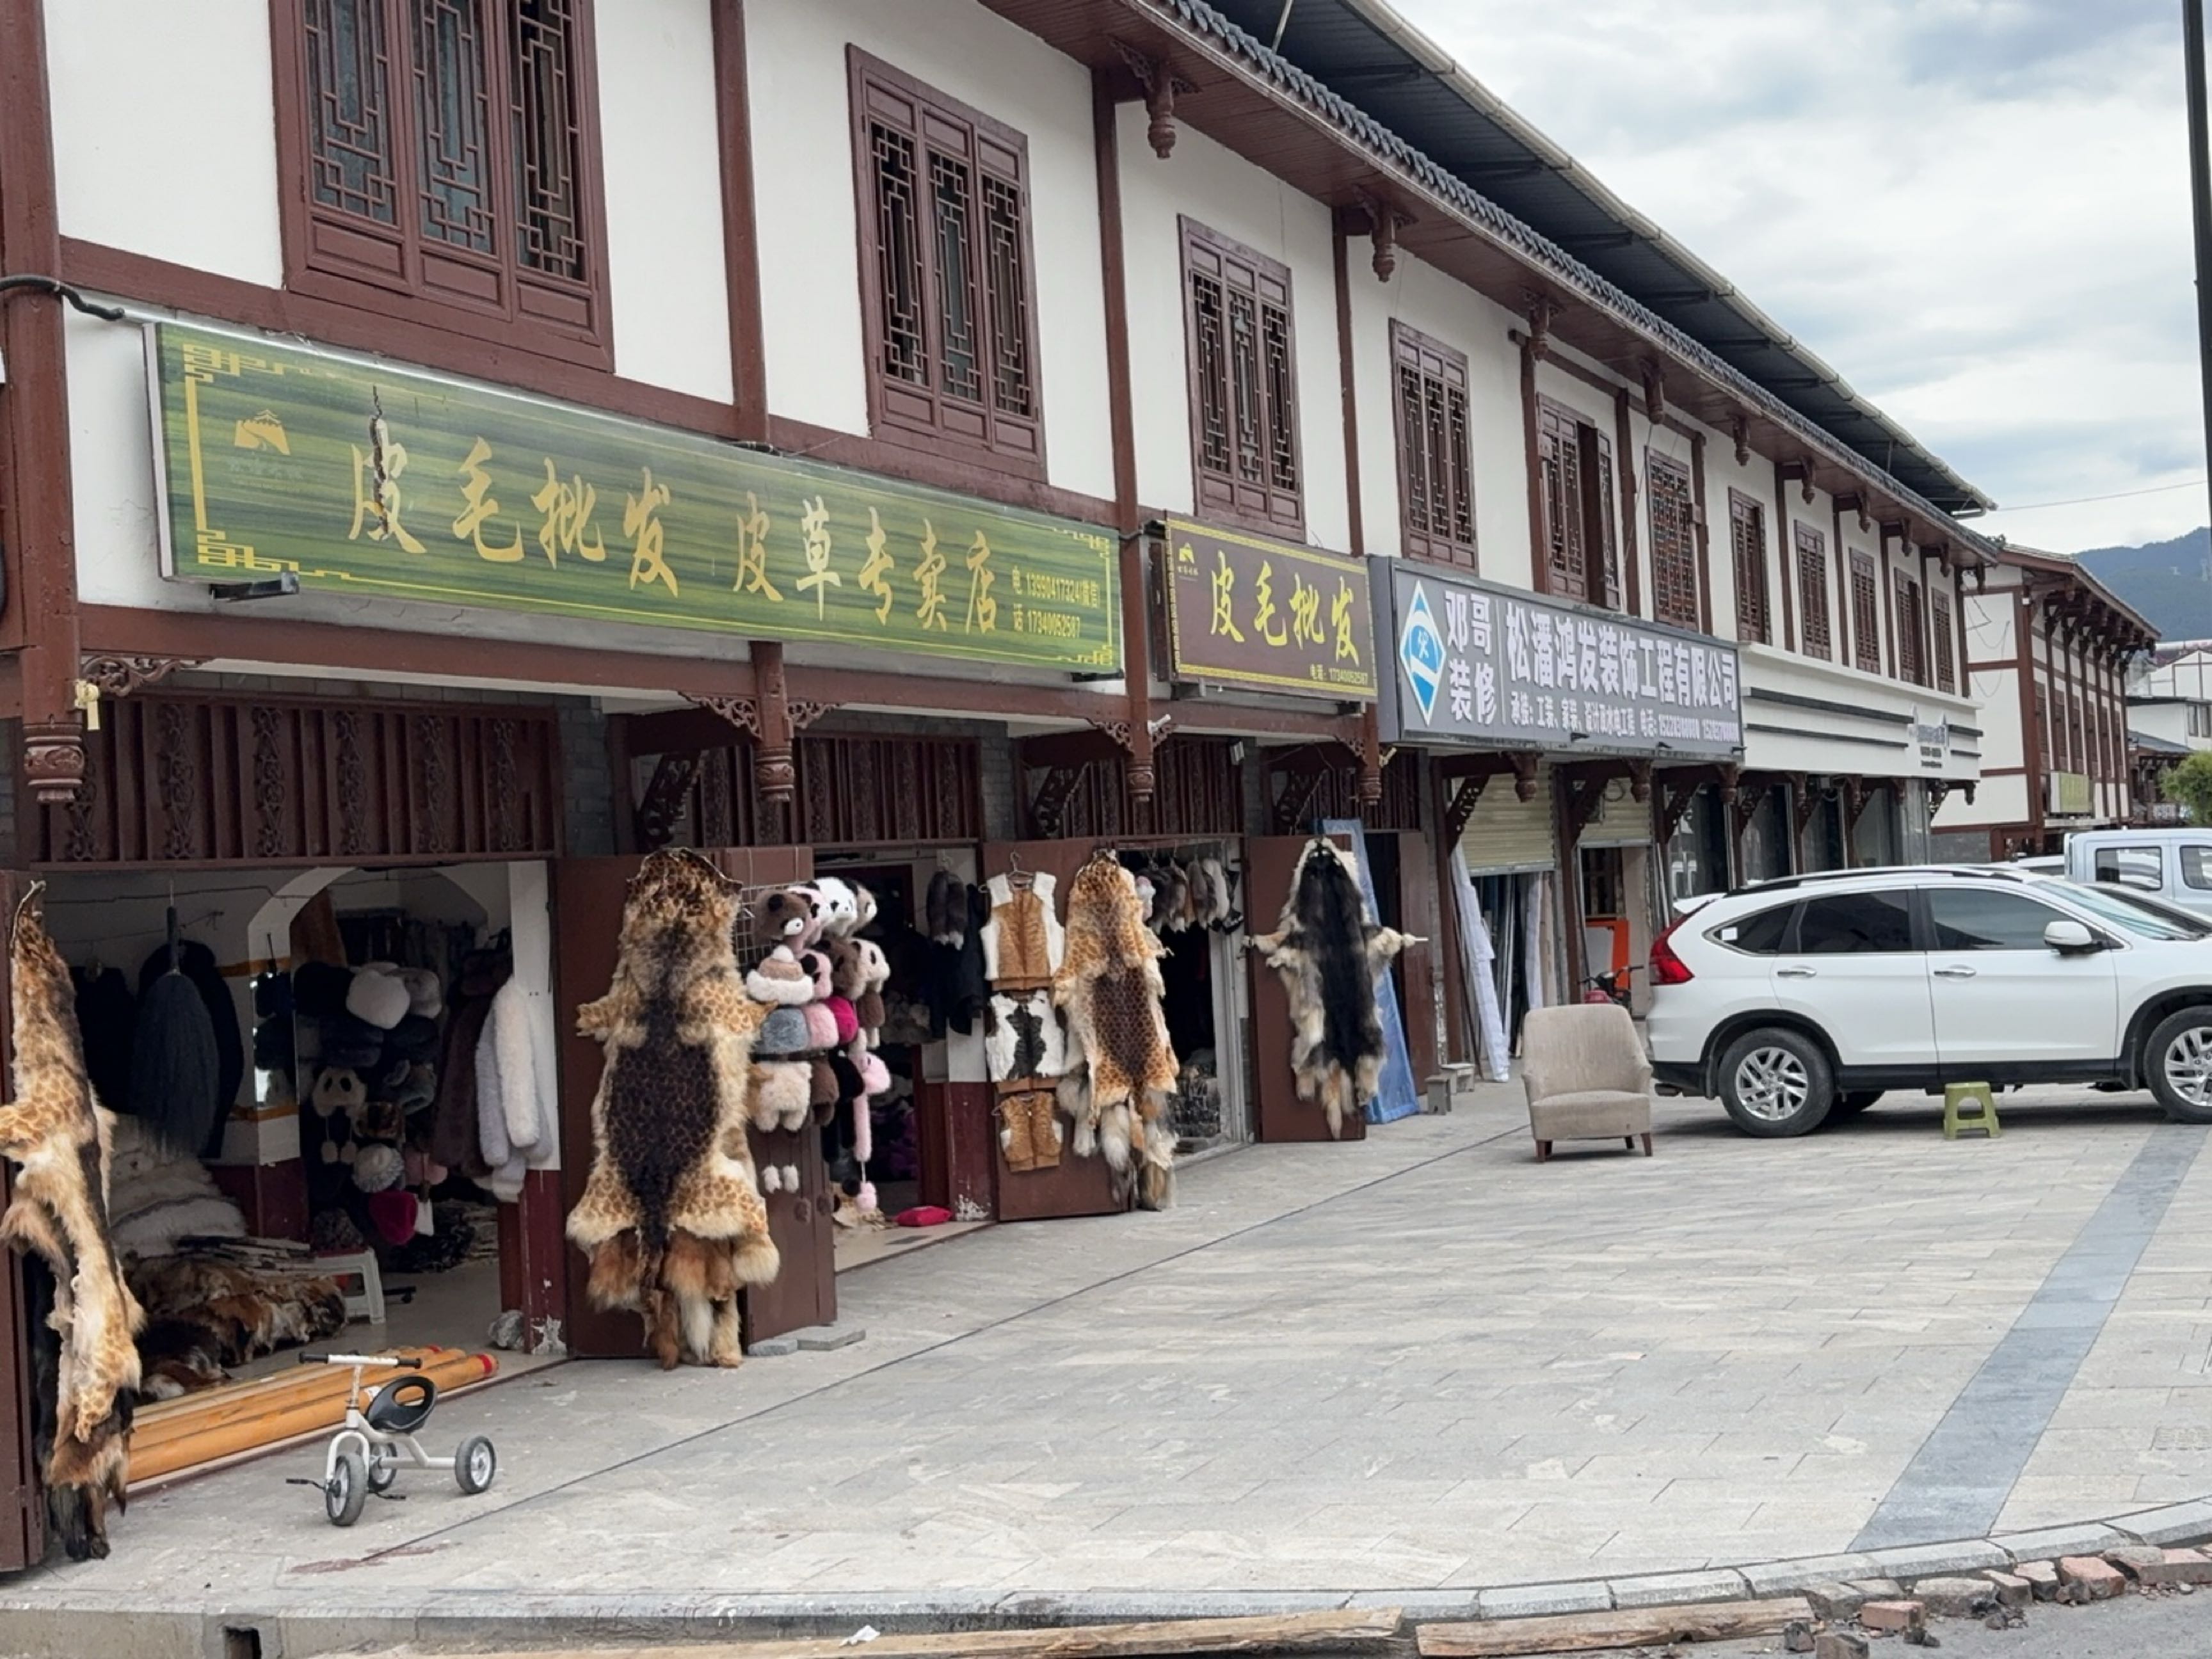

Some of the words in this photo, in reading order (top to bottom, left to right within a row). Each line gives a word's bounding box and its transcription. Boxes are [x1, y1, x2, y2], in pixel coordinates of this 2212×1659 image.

[349, 417, 678, 597] 皮毛批发
[733, 491, 997, 634] 皮草专卖店
[1211, 550, 1359, 666] 皮毛批发
[1445, 590, 1492, 655] 邓哥
[1506, 601, 1736, 711] 松潘鸿发装饰工程有限公司
[1448, 658, 1497, 725] 装修
